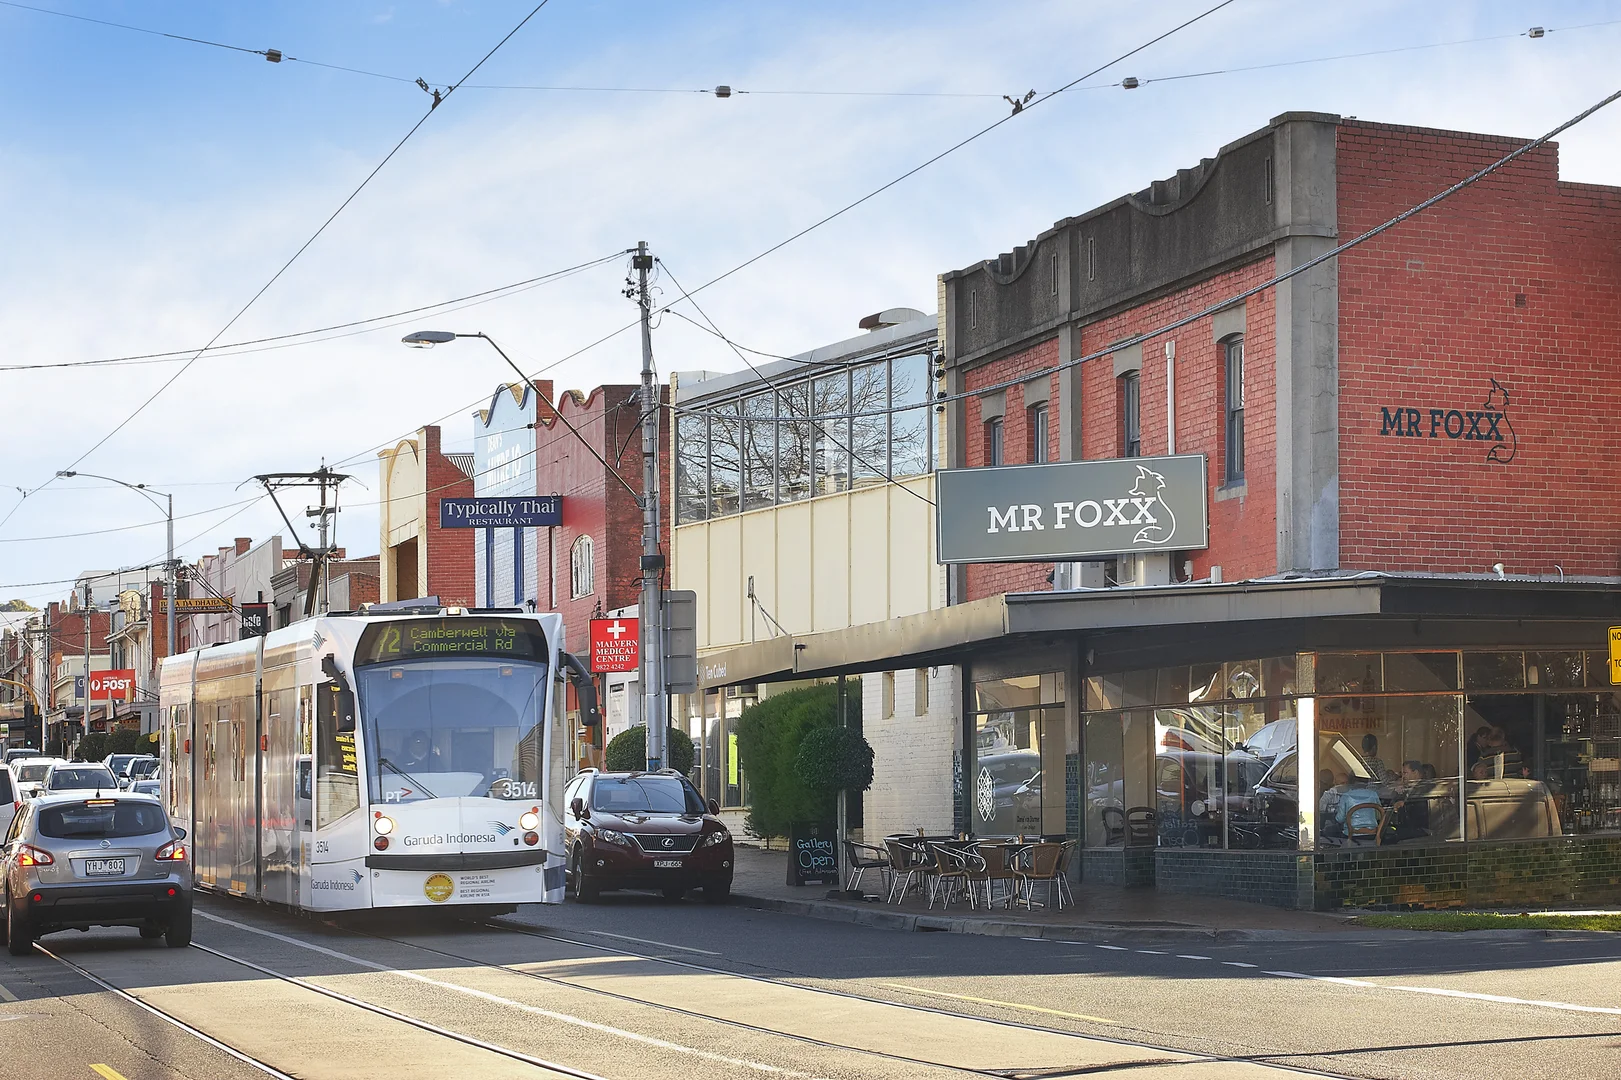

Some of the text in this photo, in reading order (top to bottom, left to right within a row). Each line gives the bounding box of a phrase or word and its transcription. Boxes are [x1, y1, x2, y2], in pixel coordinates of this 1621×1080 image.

[1380, 407, 1504, 441] MR FOXX
[444, 500, 555, 519] Typically Thai
[987, 496, 1158, 533] MR FOXX
[469, 517, 533, 526] RESTAURANT
[410, 627, 488, 639] Camberwell
[495, 626, 516, 637] via
[413, 639, 513, 652] Commercial Rd
[596, 640, 638, 648] MALVERN
[596, 647, 636, 655] MEDICAL
[103, 679, 131, 691] POST
[385, 781, 537, 802] PT 3514
[403, 832, 496, 847] Garuda Indonesia
[315, 840, 329, 853] 3514
[796, 838, 834, 855] Gallery
[87, 861, 123, 870] YHJ 802
[800, 850, 835, 869] Open
[311, 879, 354, 891] Garuda Indonesia
